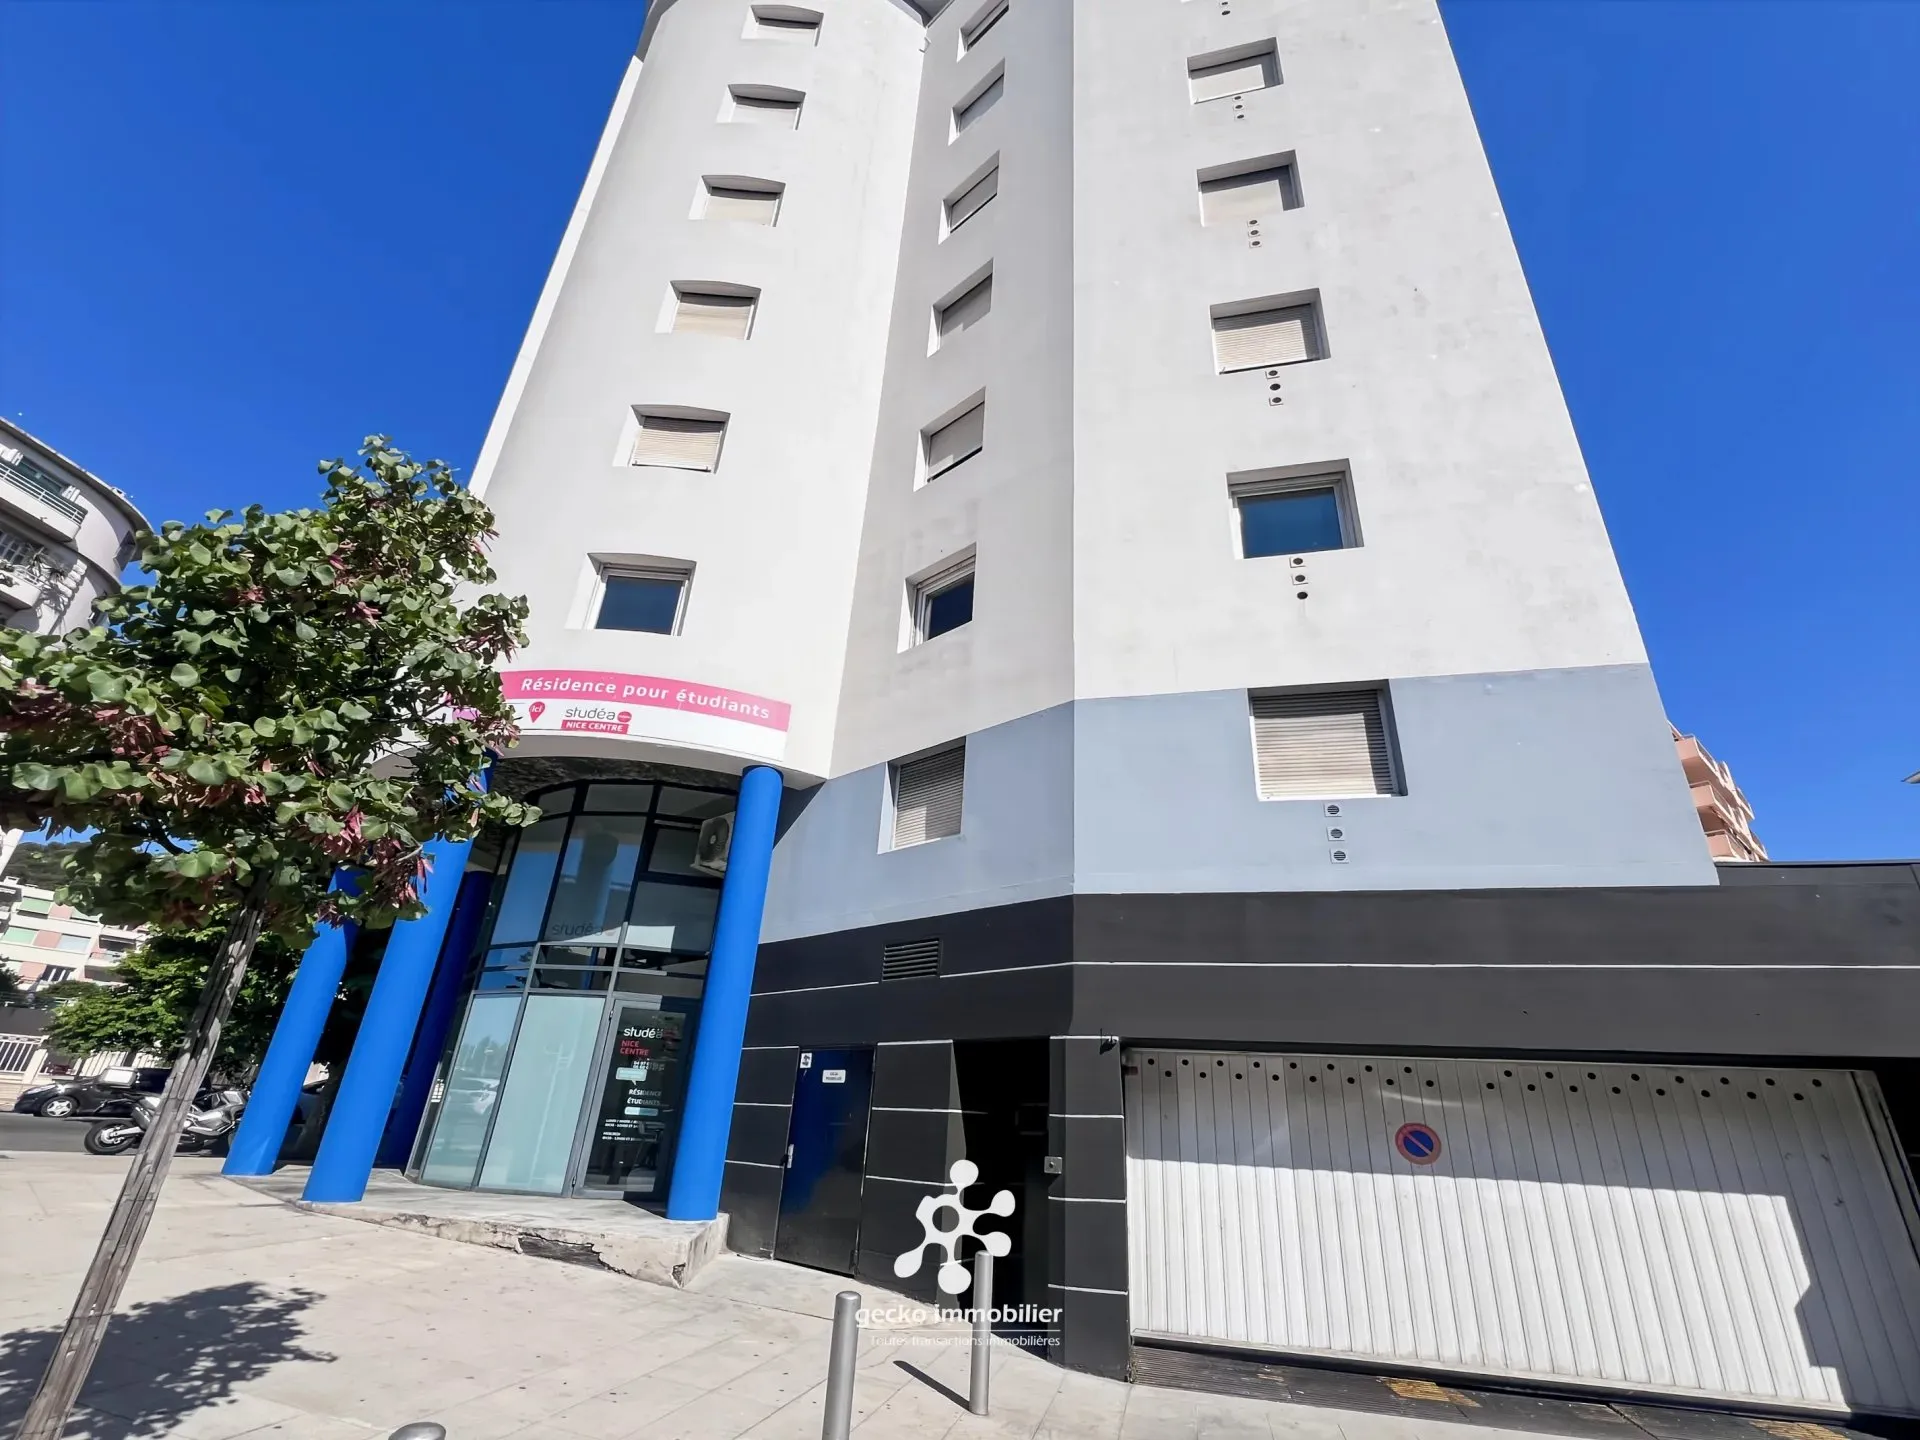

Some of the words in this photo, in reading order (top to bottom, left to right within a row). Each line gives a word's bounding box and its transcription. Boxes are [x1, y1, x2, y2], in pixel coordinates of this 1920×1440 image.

[521, 677, 616, 694] Résidence
[622, 683, 668, 700] pour
[676, 687, 770, 719] étudiants
[564, 706, 616, 721] studéa
[566, 721, 587, 730] NICE
[588, 722, 624, 732] CENTRE
[621, 1040, 640, 1048] NICE
[619, 1047, 650, 1056] CENTRE
